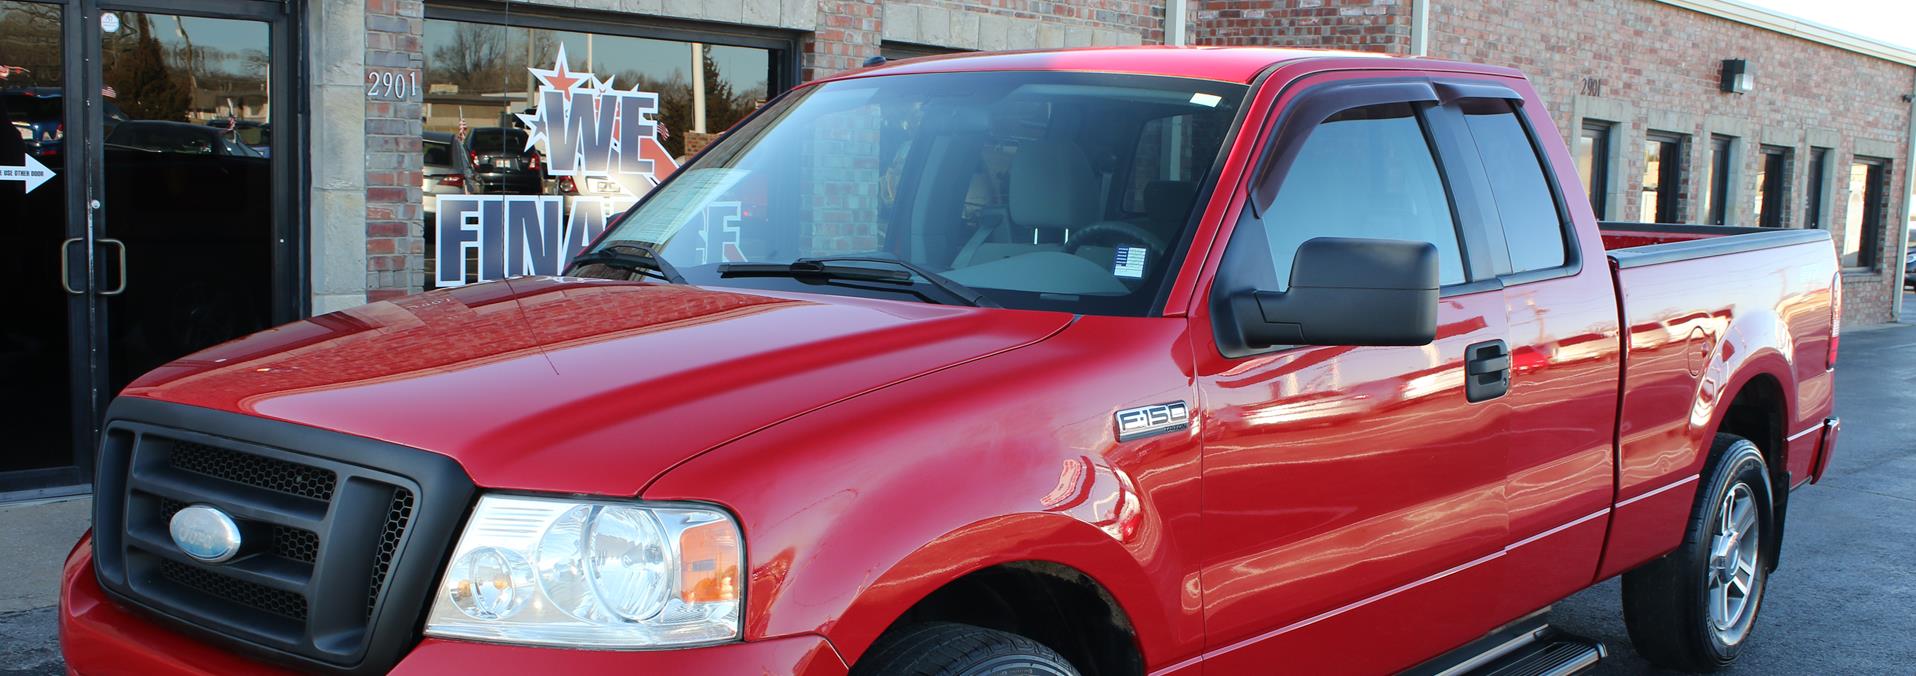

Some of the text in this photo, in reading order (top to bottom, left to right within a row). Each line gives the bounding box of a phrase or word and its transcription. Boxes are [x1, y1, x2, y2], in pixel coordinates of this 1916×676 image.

[367, 71, 416, 99] 2901
[1580, 78, 1600, 96] 2901
[540, 87, 659, 176] WE
